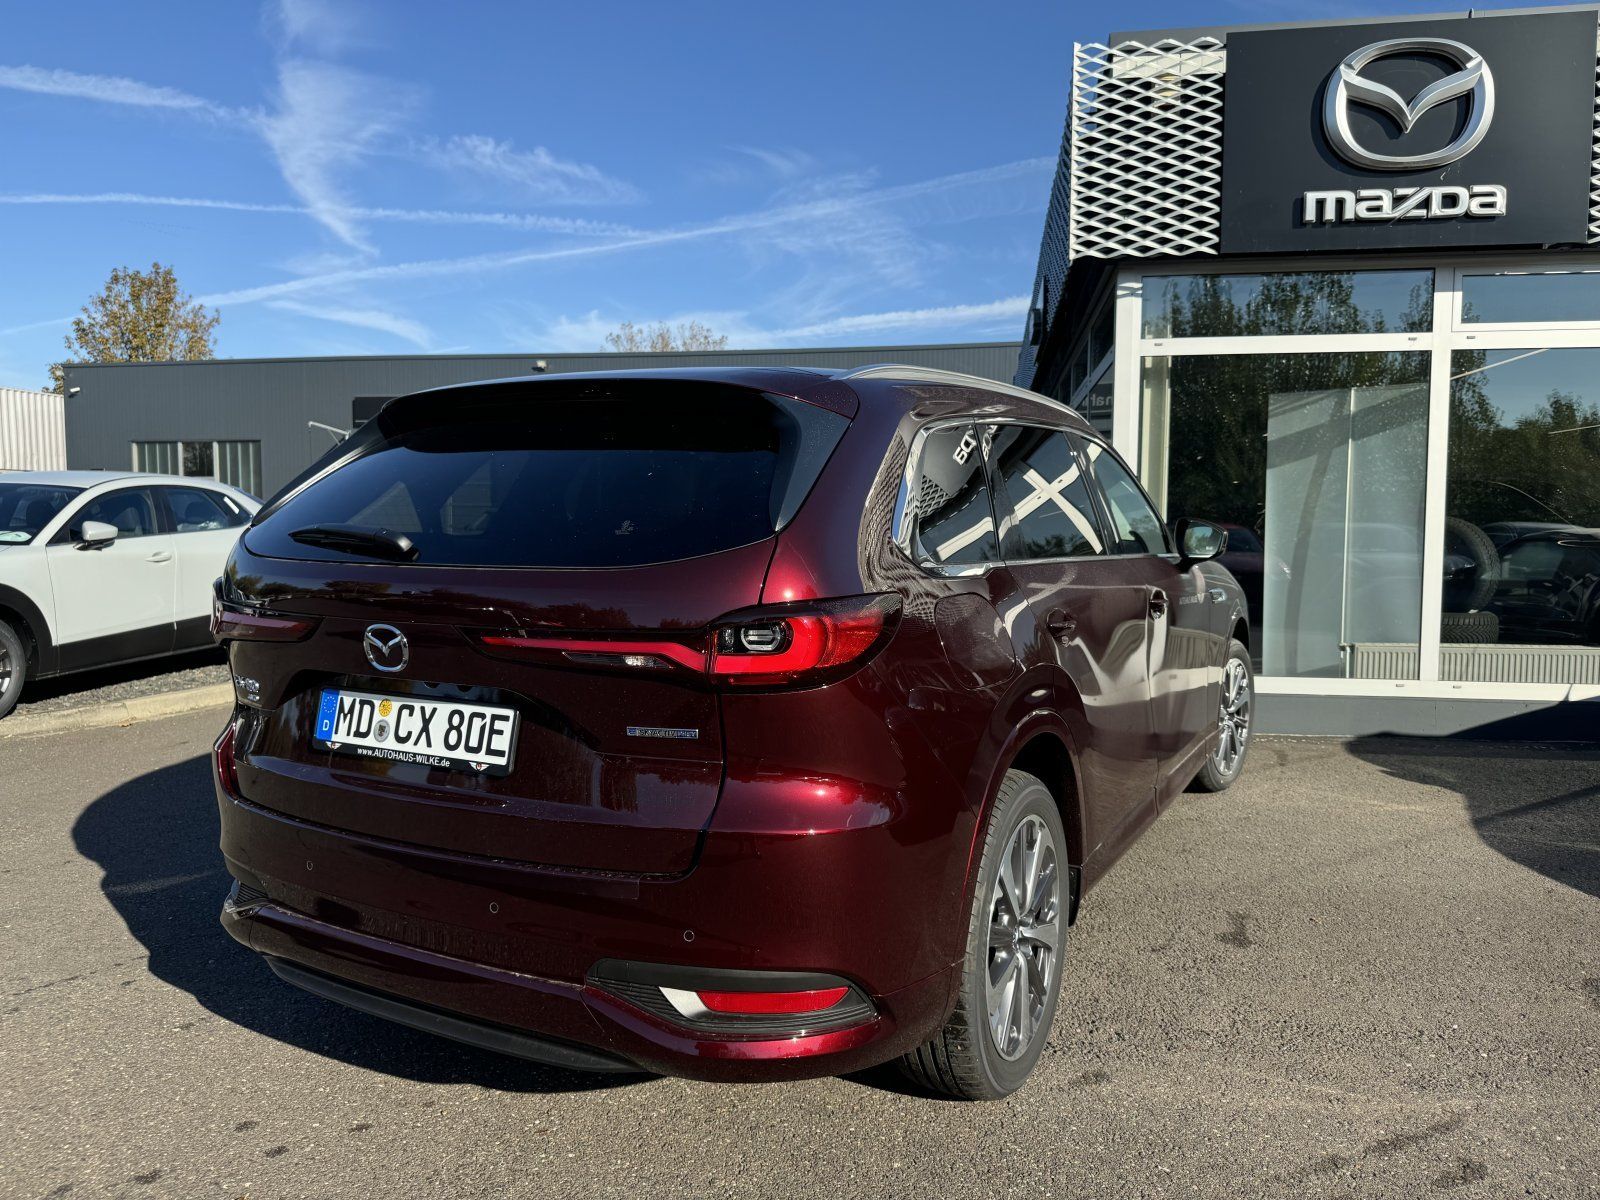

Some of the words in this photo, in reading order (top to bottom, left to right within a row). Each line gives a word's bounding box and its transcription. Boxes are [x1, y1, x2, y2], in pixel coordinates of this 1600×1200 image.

[322, 719, 330, 731] D
[334, 696, 375, 738] MD
[394, 703, 438, 748] CX
[443, 708, 510, 758] 80E
[357, 747, 450, 767] www.AUTOHAUS-WILKE.de
